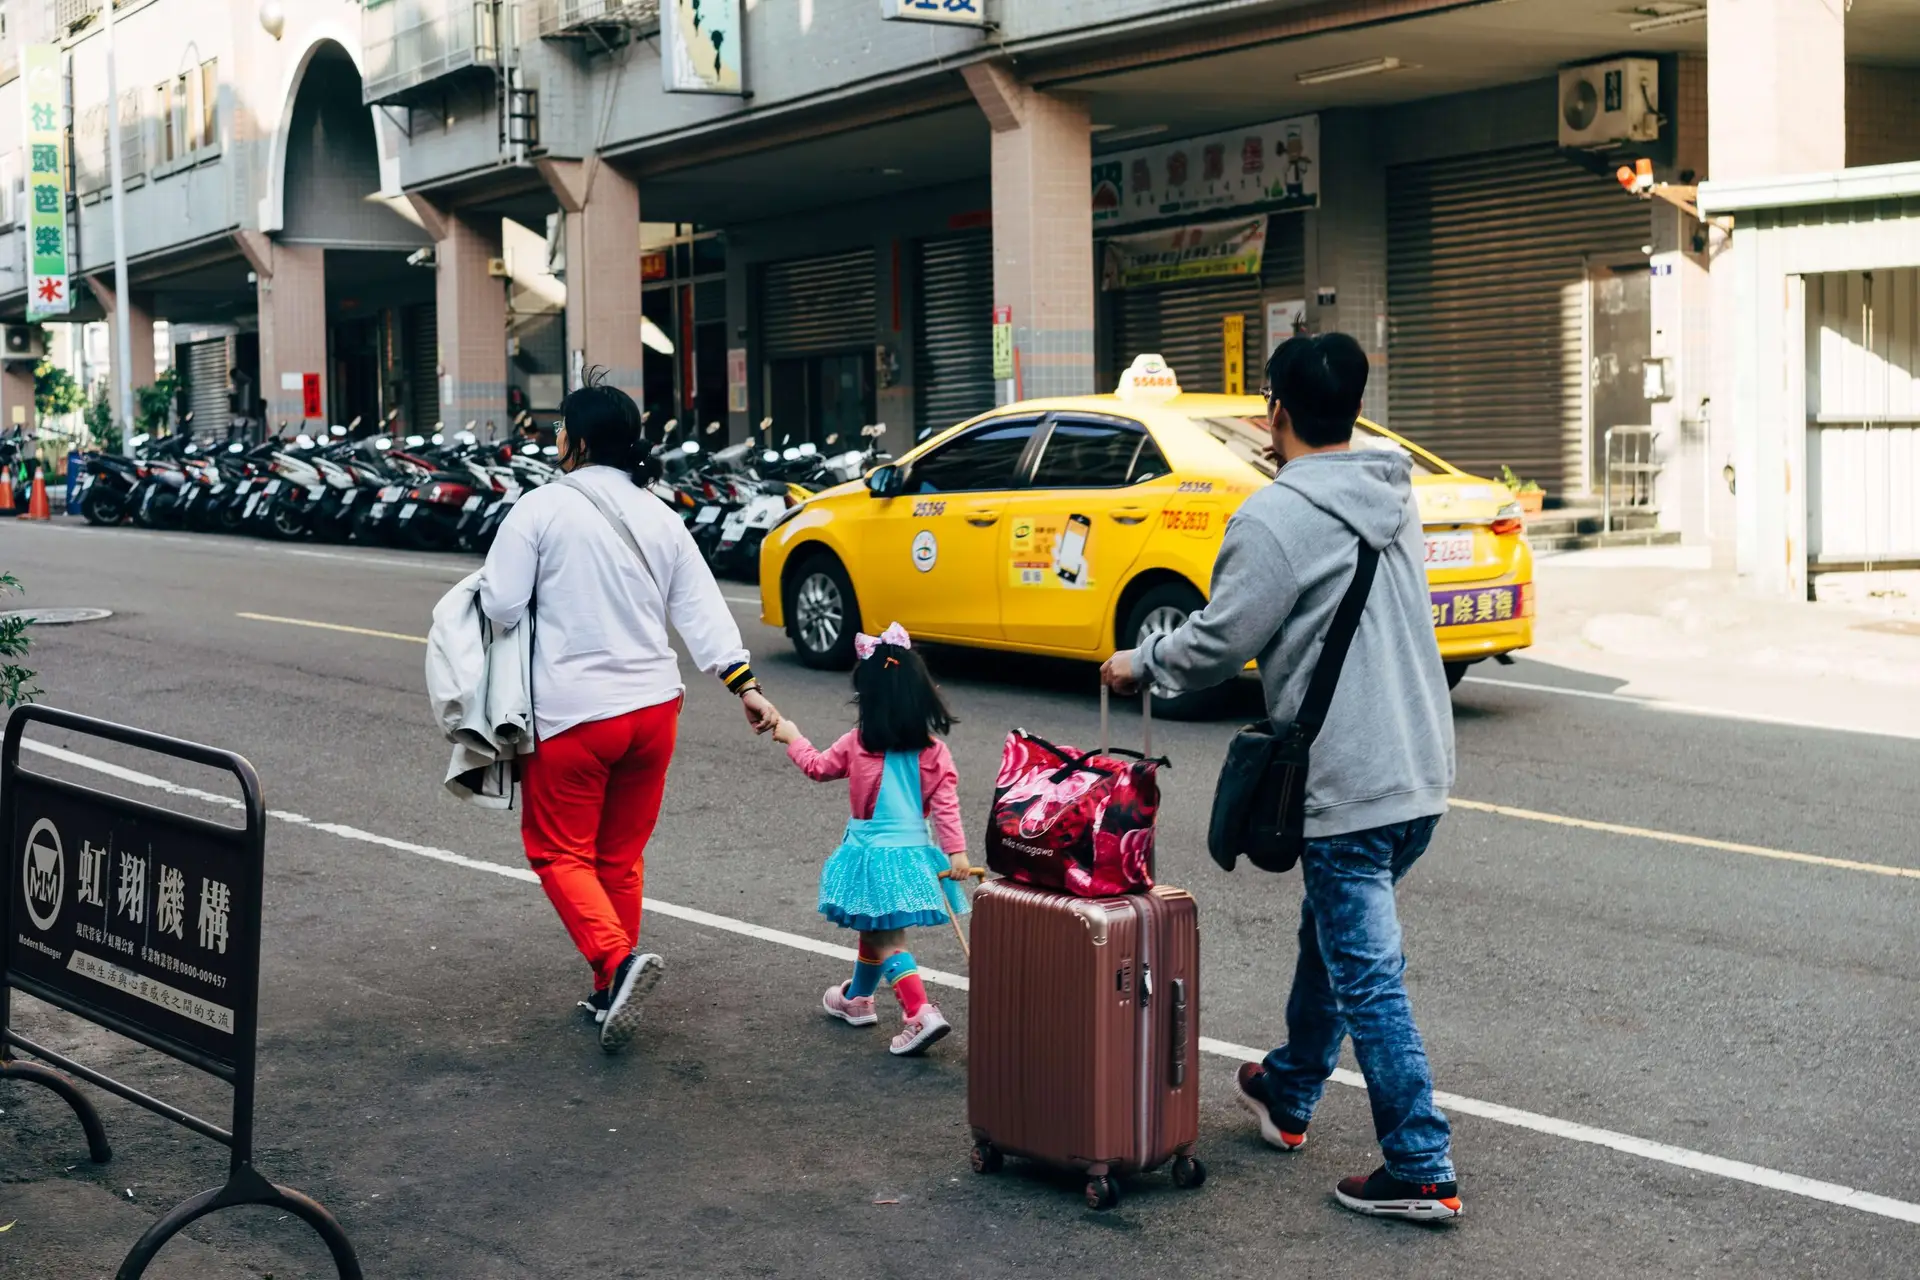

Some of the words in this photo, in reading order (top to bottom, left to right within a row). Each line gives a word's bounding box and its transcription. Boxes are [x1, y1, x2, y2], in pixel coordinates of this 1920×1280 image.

[31, 102, 61, 256] 社頭芭樂
[1133, 376, 1173, 387] 55688
[1177, 481, 1212, 493] 25356
[912, 501, 946, 517] 25356
[1162, 509, 1210, 531] TDE-2633
[78, 840, 231, 954] 虹翔機構
[19, 934, 39, 951] Modern
[39, 942, 62, 960] Manager
